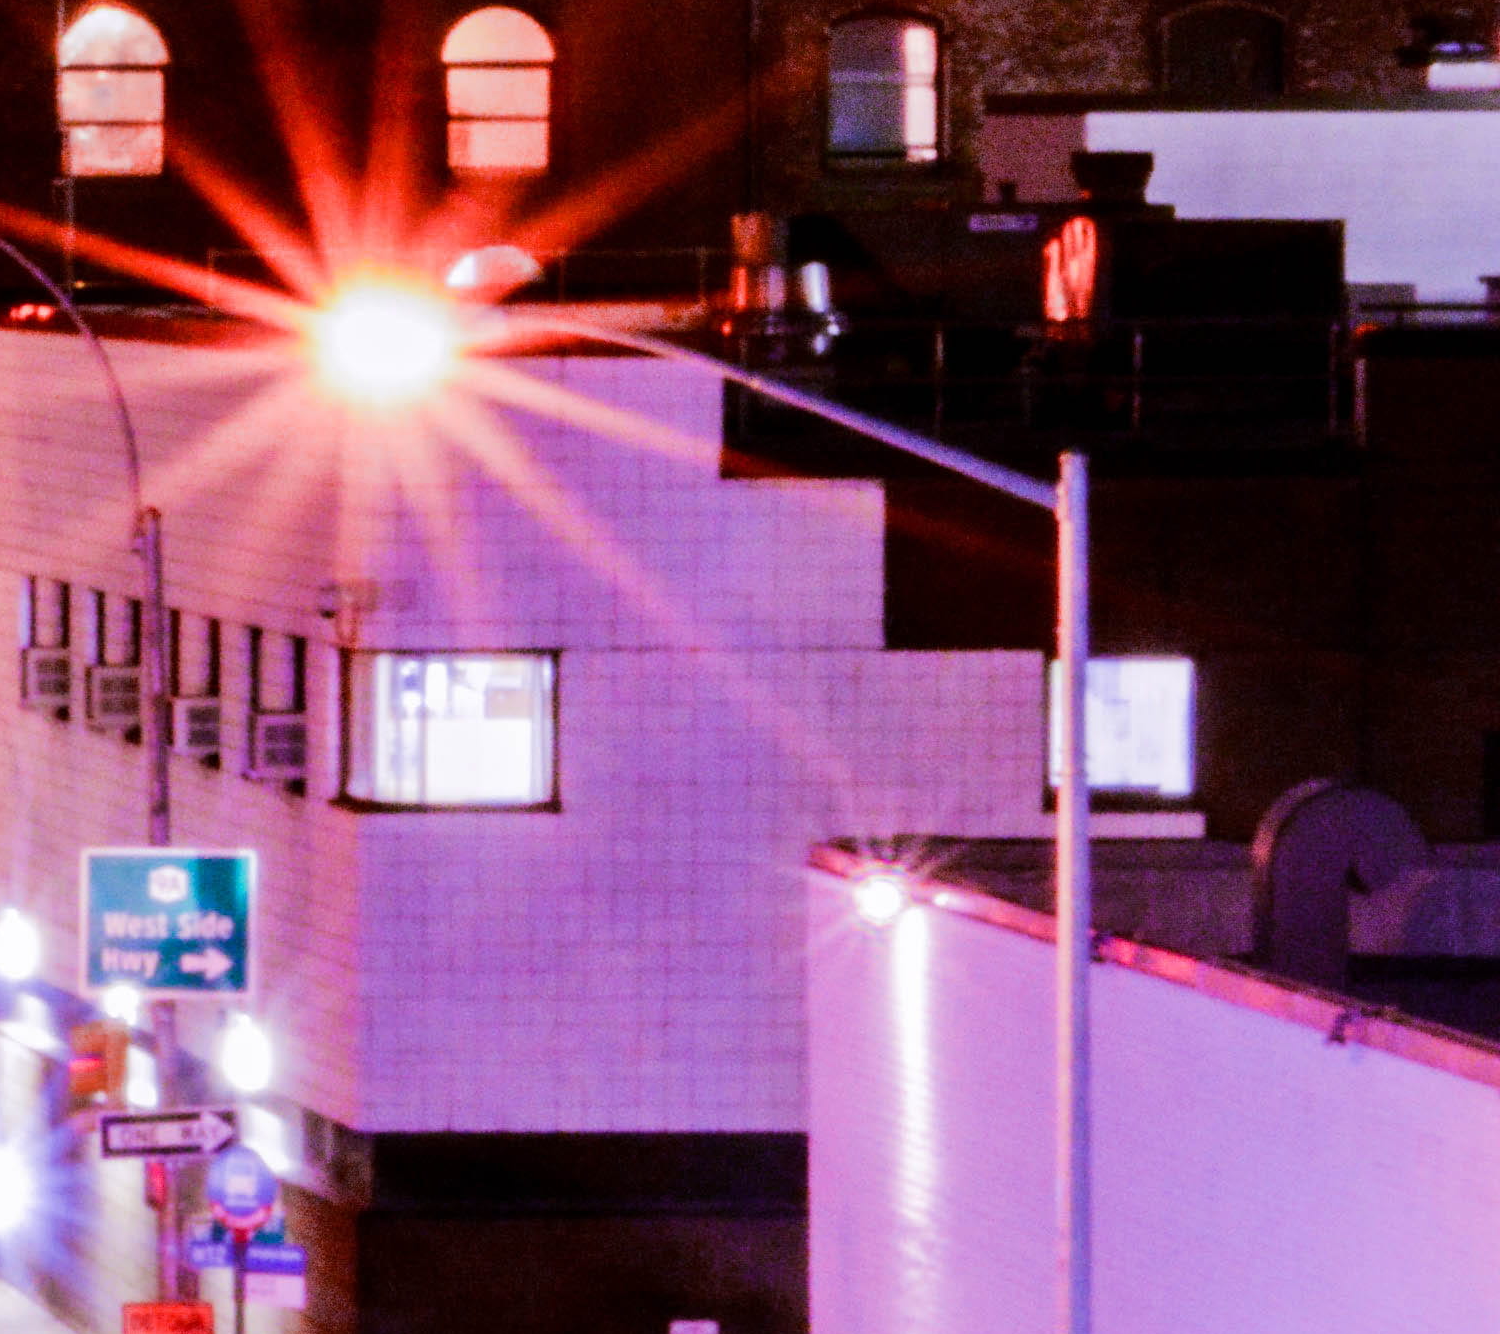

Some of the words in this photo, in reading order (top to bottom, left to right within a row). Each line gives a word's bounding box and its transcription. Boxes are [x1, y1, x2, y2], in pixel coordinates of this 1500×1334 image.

[104, 912, 168, 939] West
[177, 911, 234, 940] Side
[101, 946, 161, 979] Hwy
